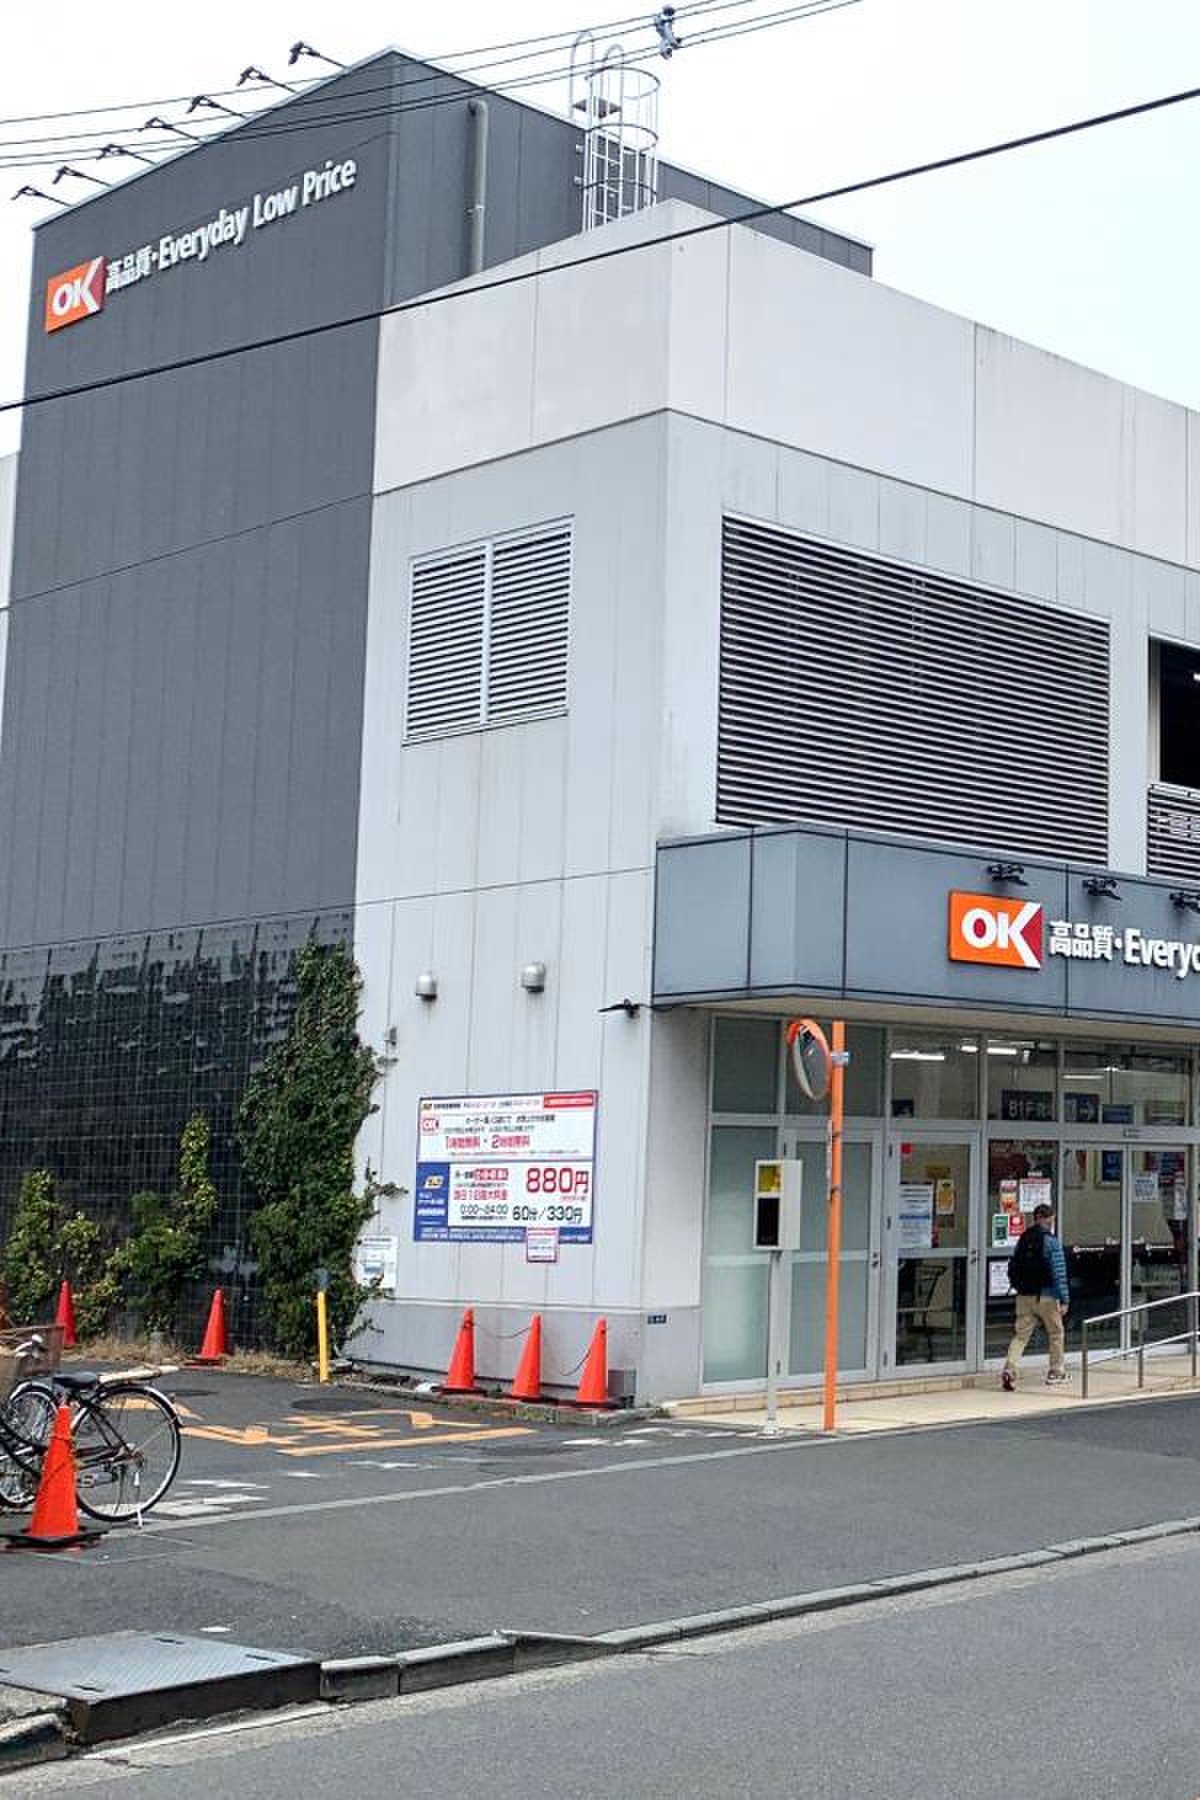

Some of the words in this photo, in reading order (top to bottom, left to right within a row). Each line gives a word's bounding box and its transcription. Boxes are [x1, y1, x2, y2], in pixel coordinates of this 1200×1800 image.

[252, 182, 298, 229] Low
[302, 159, 357, 206] Price
[52, 256, 104, 316] OK
[961, 903, 1041, 968] OK
[527, 1167, 589, 1195] 880円
